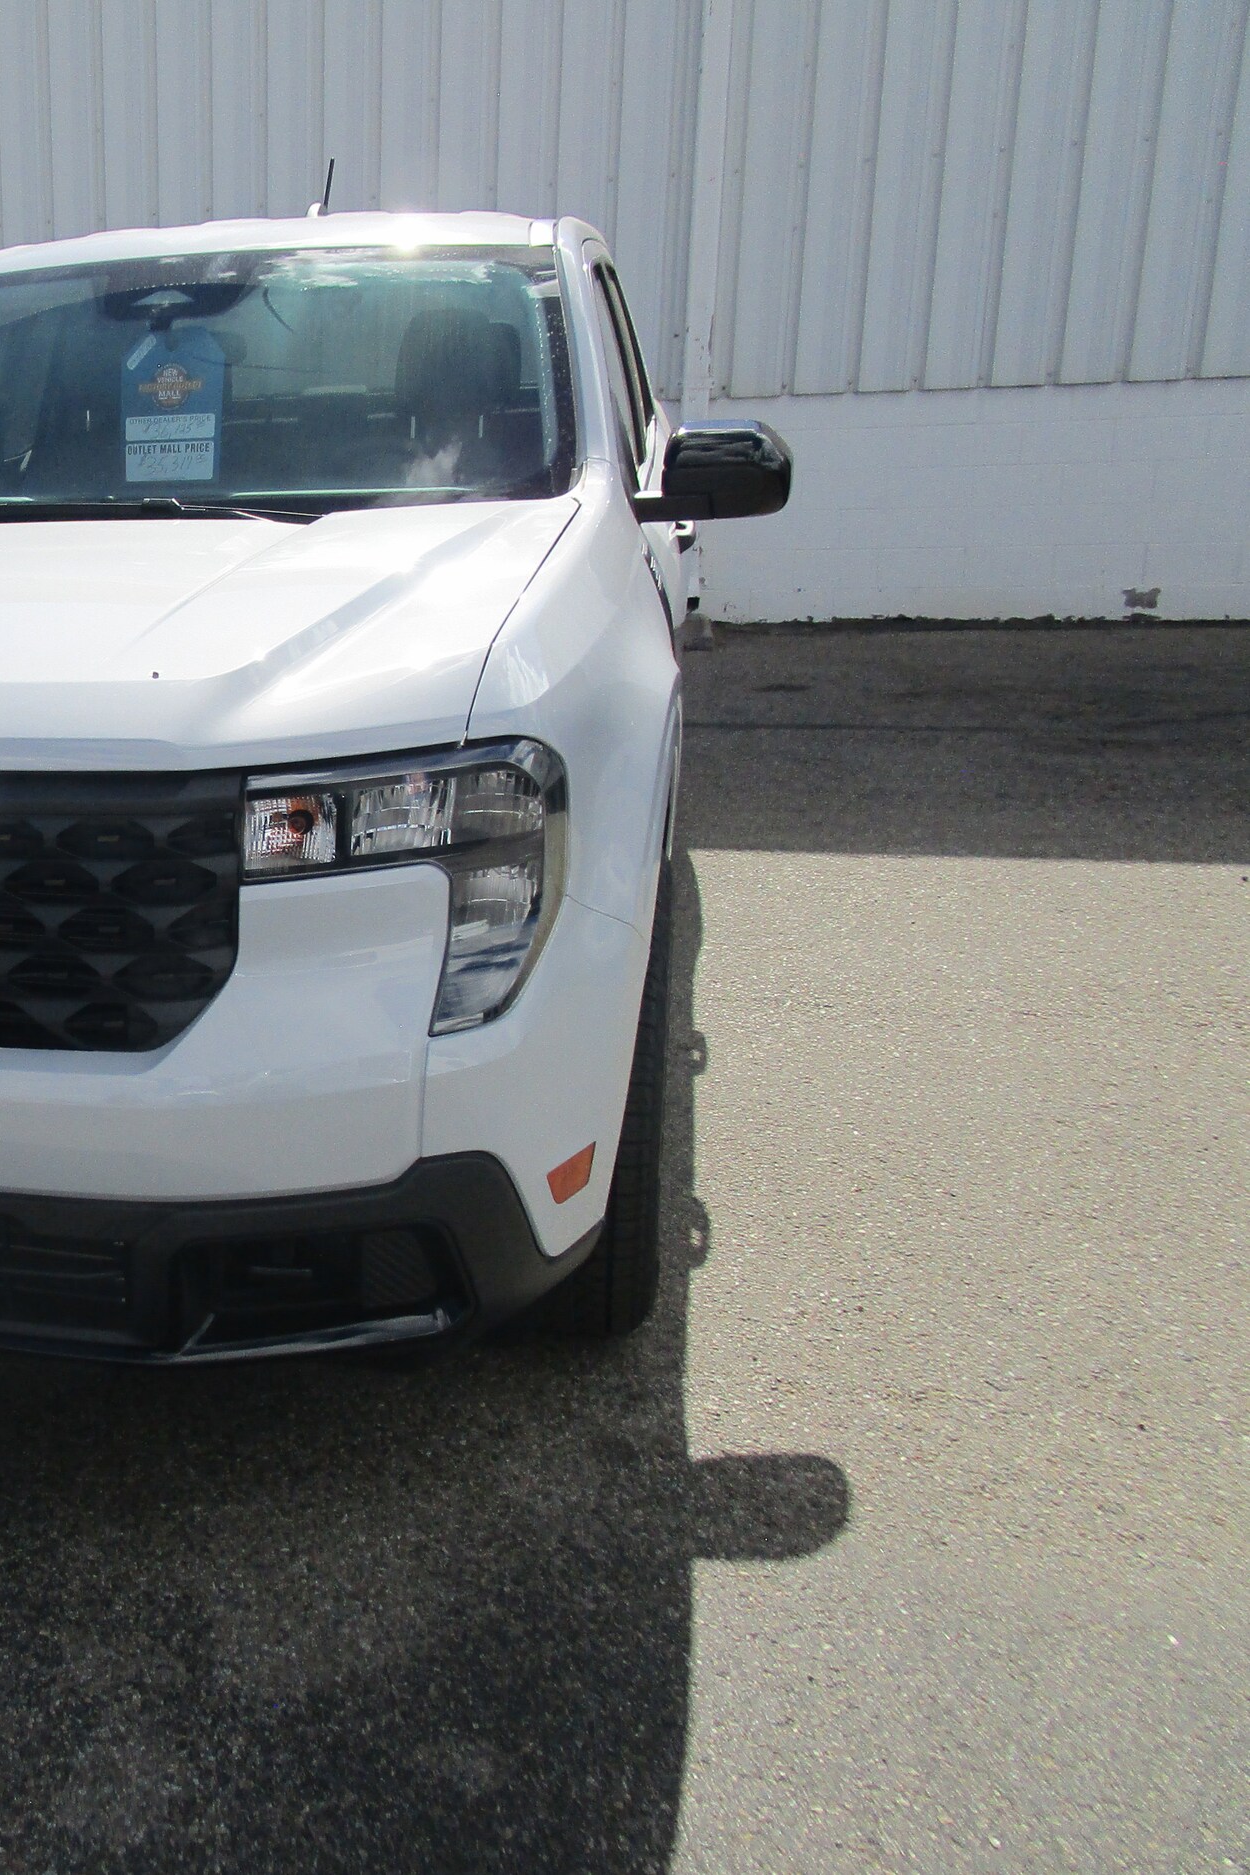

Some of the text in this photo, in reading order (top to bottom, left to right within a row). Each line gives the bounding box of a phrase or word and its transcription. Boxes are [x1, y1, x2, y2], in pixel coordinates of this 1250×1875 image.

[153, 416, 188, 424] DEALER'S
[127, 442, 211, 456] OUTLET MALL PRICE
